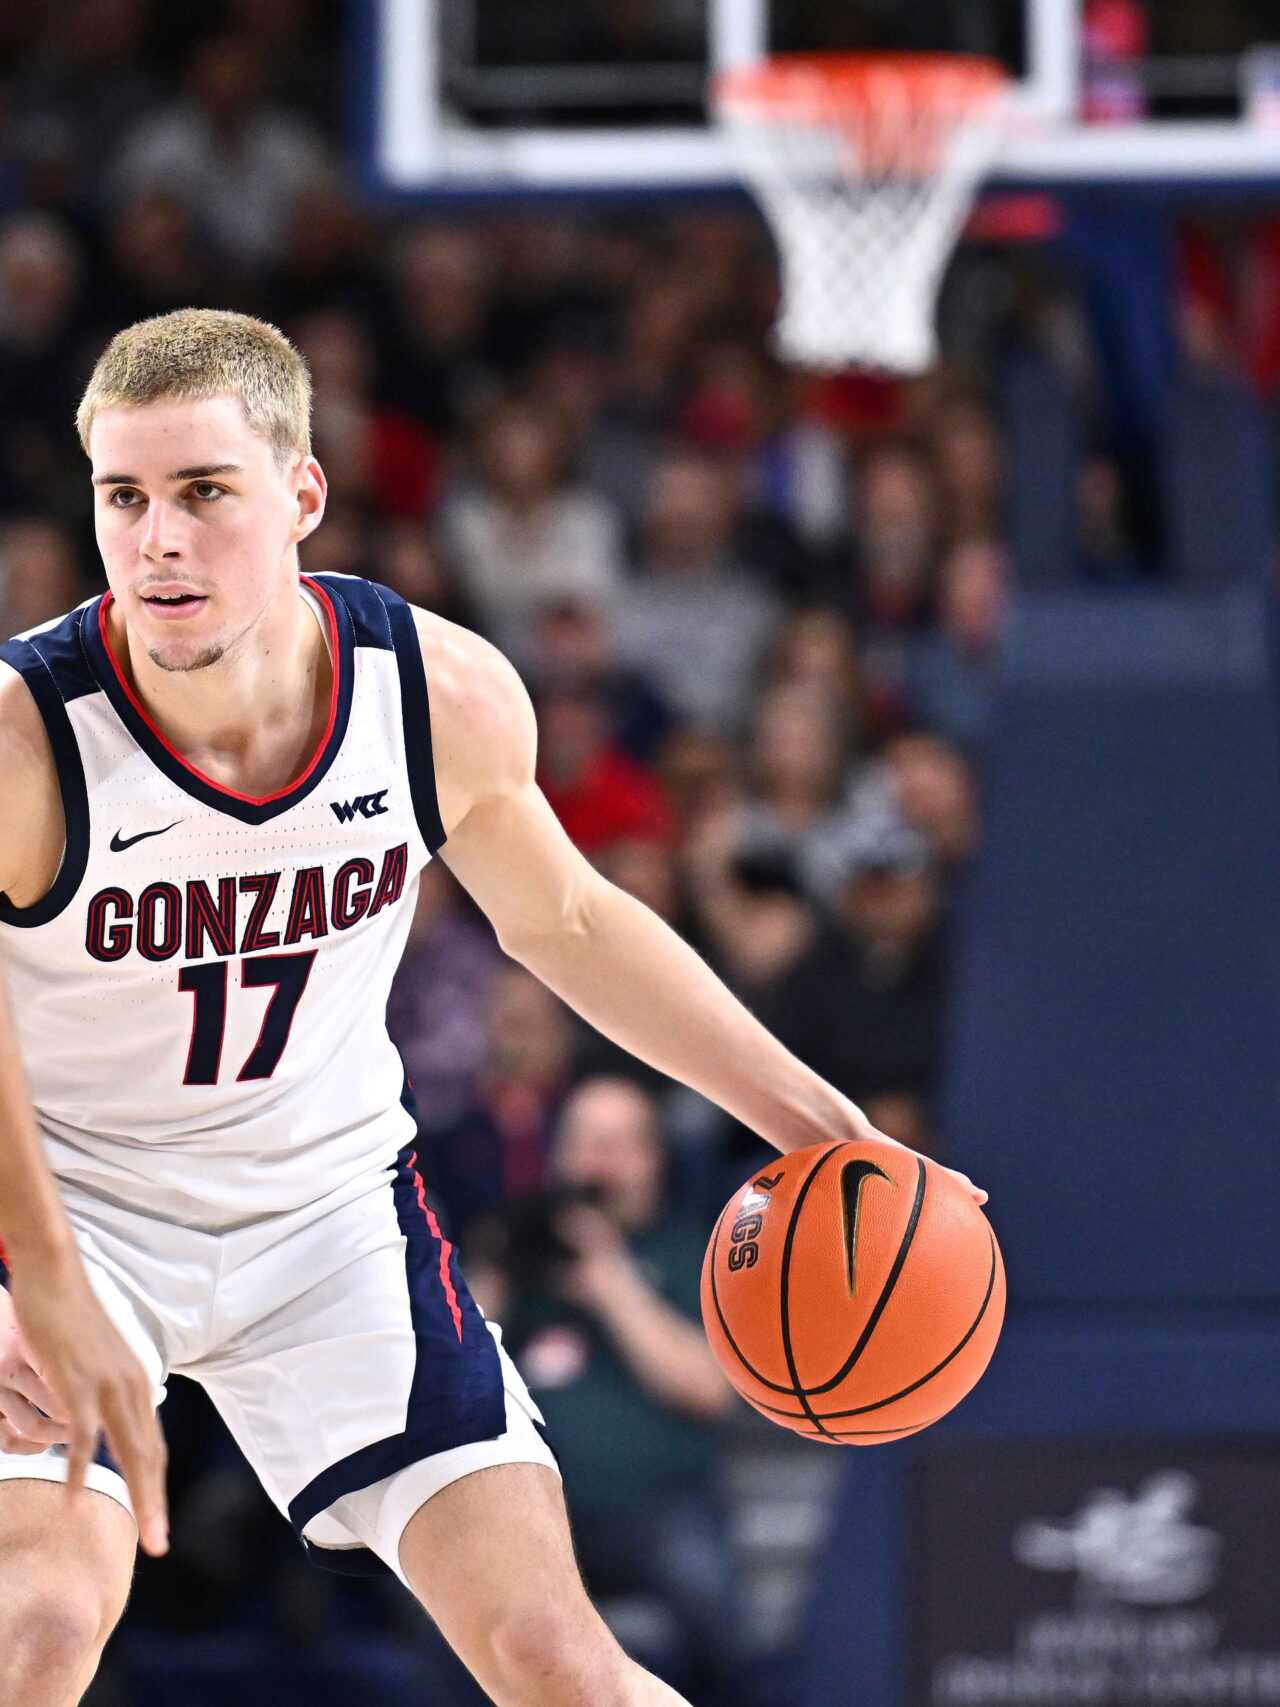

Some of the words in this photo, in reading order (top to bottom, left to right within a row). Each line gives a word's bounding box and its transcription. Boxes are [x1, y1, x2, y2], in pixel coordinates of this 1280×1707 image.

[329, 788, 389, 824] WCC
[85, 842, 408, 962] GONZAGA
[178, 949, 319, 1086] 17
[728, 1171, 785, 1272] ZAGS
